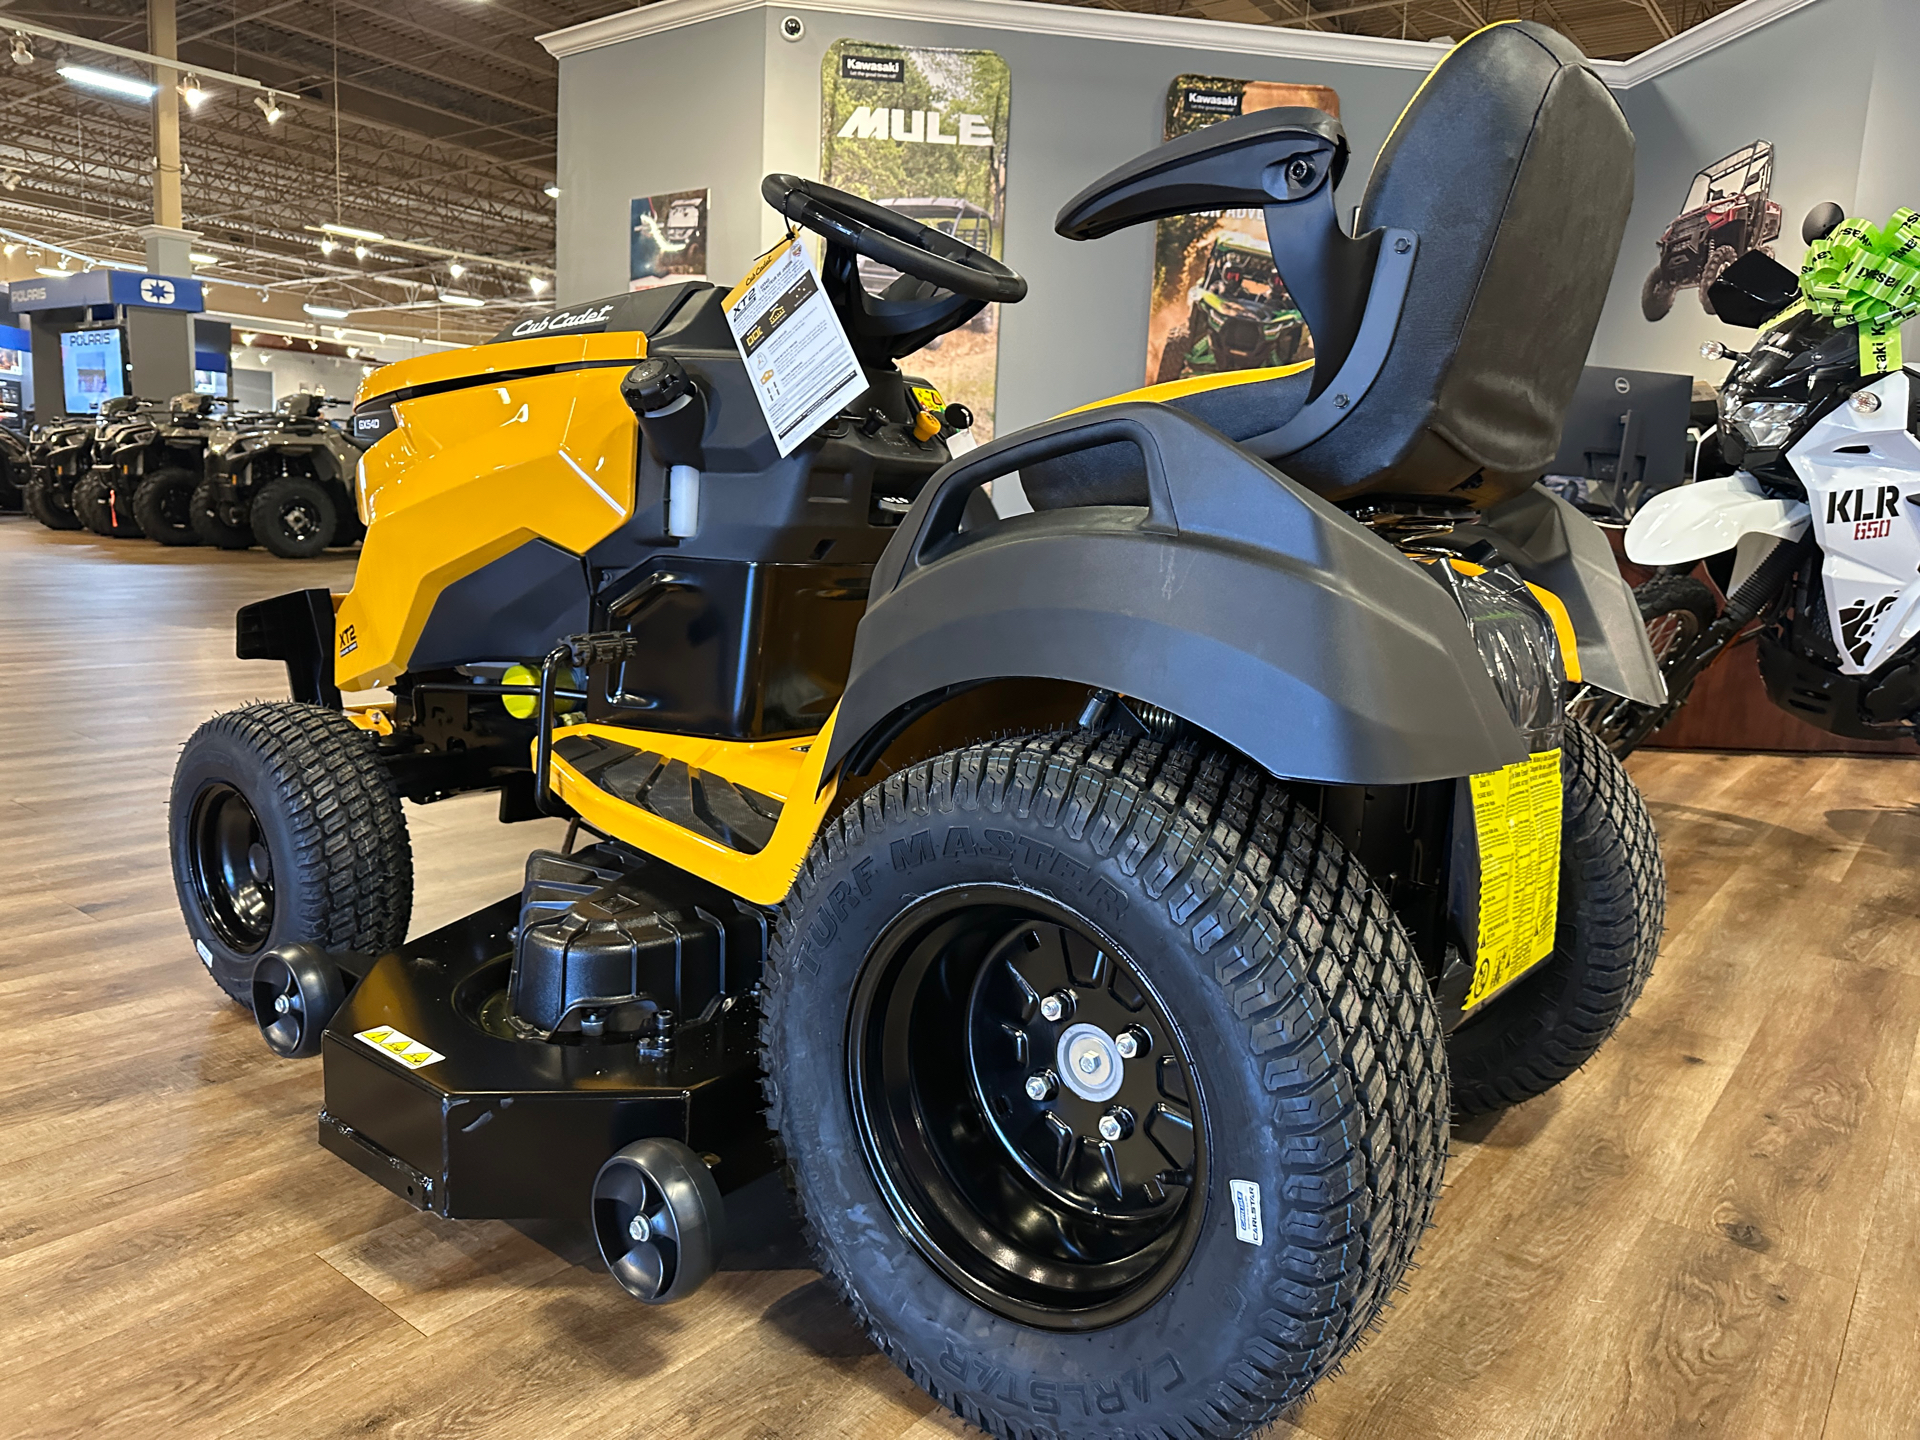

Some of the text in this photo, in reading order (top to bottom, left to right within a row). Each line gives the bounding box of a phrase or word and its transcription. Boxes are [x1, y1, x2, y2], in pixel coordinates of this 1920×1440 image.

[847, 58, 899, 73] Kawasaki
[1188, 92, 1238, 106] Kawasaki
[836, 106, 995, 147] MULE
[745, 273, 757, 286] Cub
[755, 255, 773, 276] Cadet
[11, 287, 47, 303] POLARIS
[733, 287, 756, 317] XT2
[512, 304, 614, 337] Cub Cadet
[69, 333, 111, 347] POLARIS
[1826, 485, 1900, 524] KLR
[1853, 519, 1891, 540] 650
[339, 624, 357, 649] XT2
[795, 826, 1130, 978] TURF MASTER
[1249, 1186, 1258, 1241] CARLSTAR
[938, 1337, 1188, 1417] CARLSTAR
